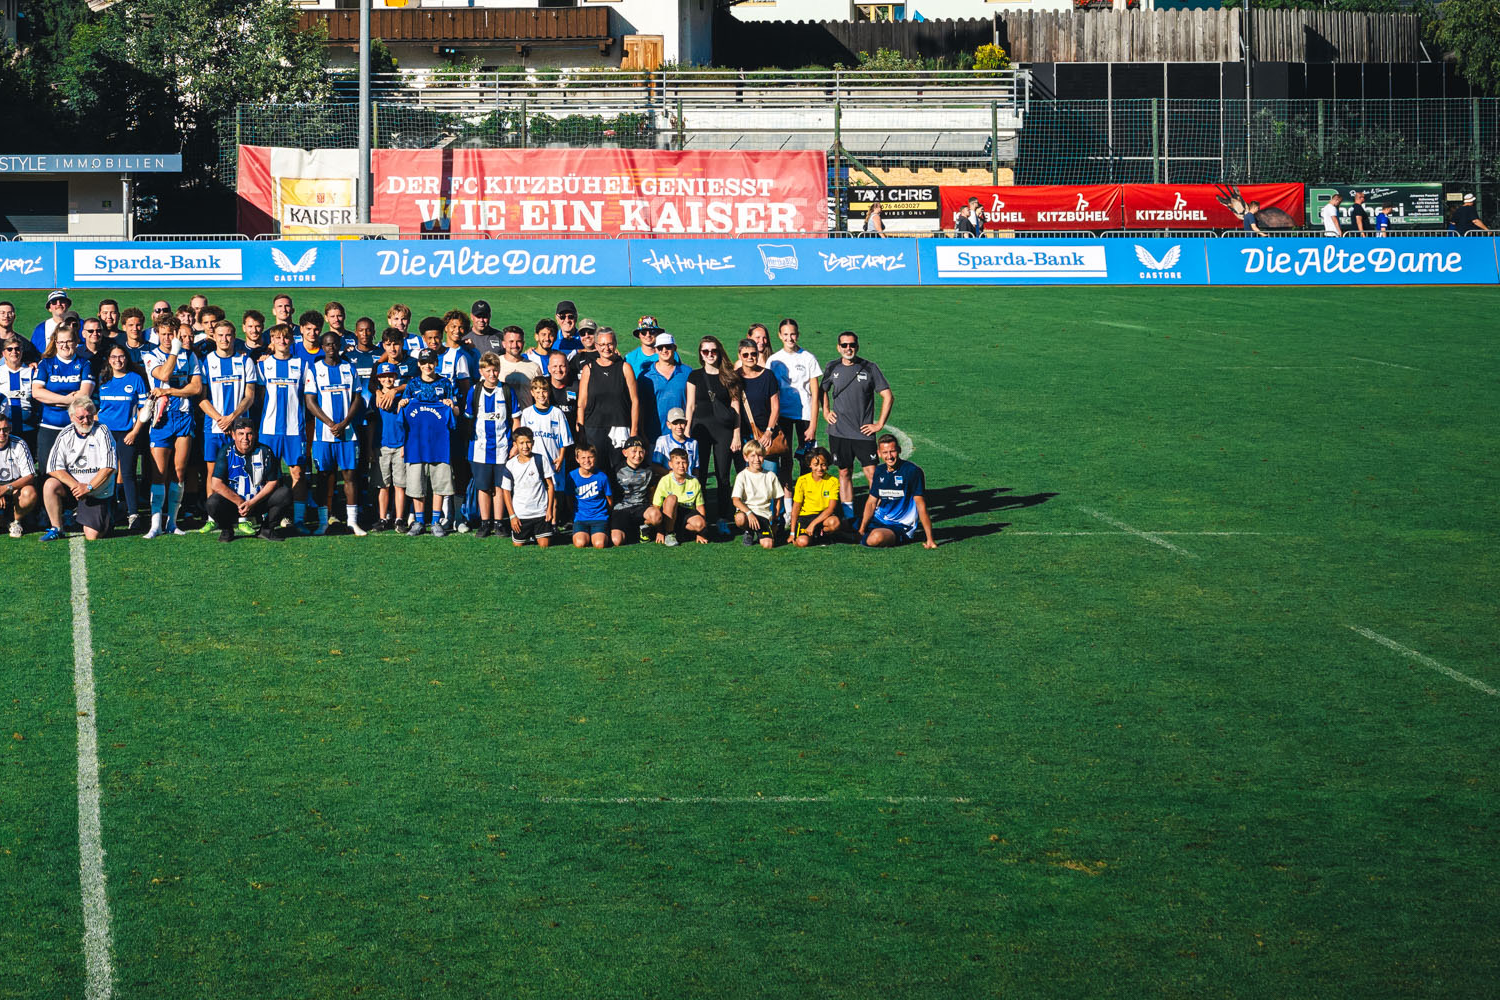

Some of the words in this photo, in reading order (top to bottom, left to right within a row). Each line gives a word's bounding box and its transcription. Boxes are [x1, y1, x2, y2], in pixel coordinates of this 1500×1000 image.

[55, 158, 165, 169] IMMOBILIEN
[386, 176, 440, 194] DER
[448, 176, 478, 194] FC
[484, 173, 635, 195] KITZBÜHEL
[641, 177, 774, 197] GENIESST
[888, 189, 933, 201] CHRIS
[290, 207, 351, 226] KAISER
[415, 200, 506, 231] WIE
[520, 200, 605, 231] EIN
[619, 200, 806, 233] KAISER.
[94, 255, 221, 272] Sparda-Bank
[376, 248, 426, 276] Die
[429, 246, 500, 278] Alte
[502, 250, 596, 275] Dame
[958, 252, 1086, 269] Sparda-Bank
[1240, 246, 1292, 274] Die
[1294, 244, 1366, 276] Alte
[1367, 248, 1462, 274] Dame
